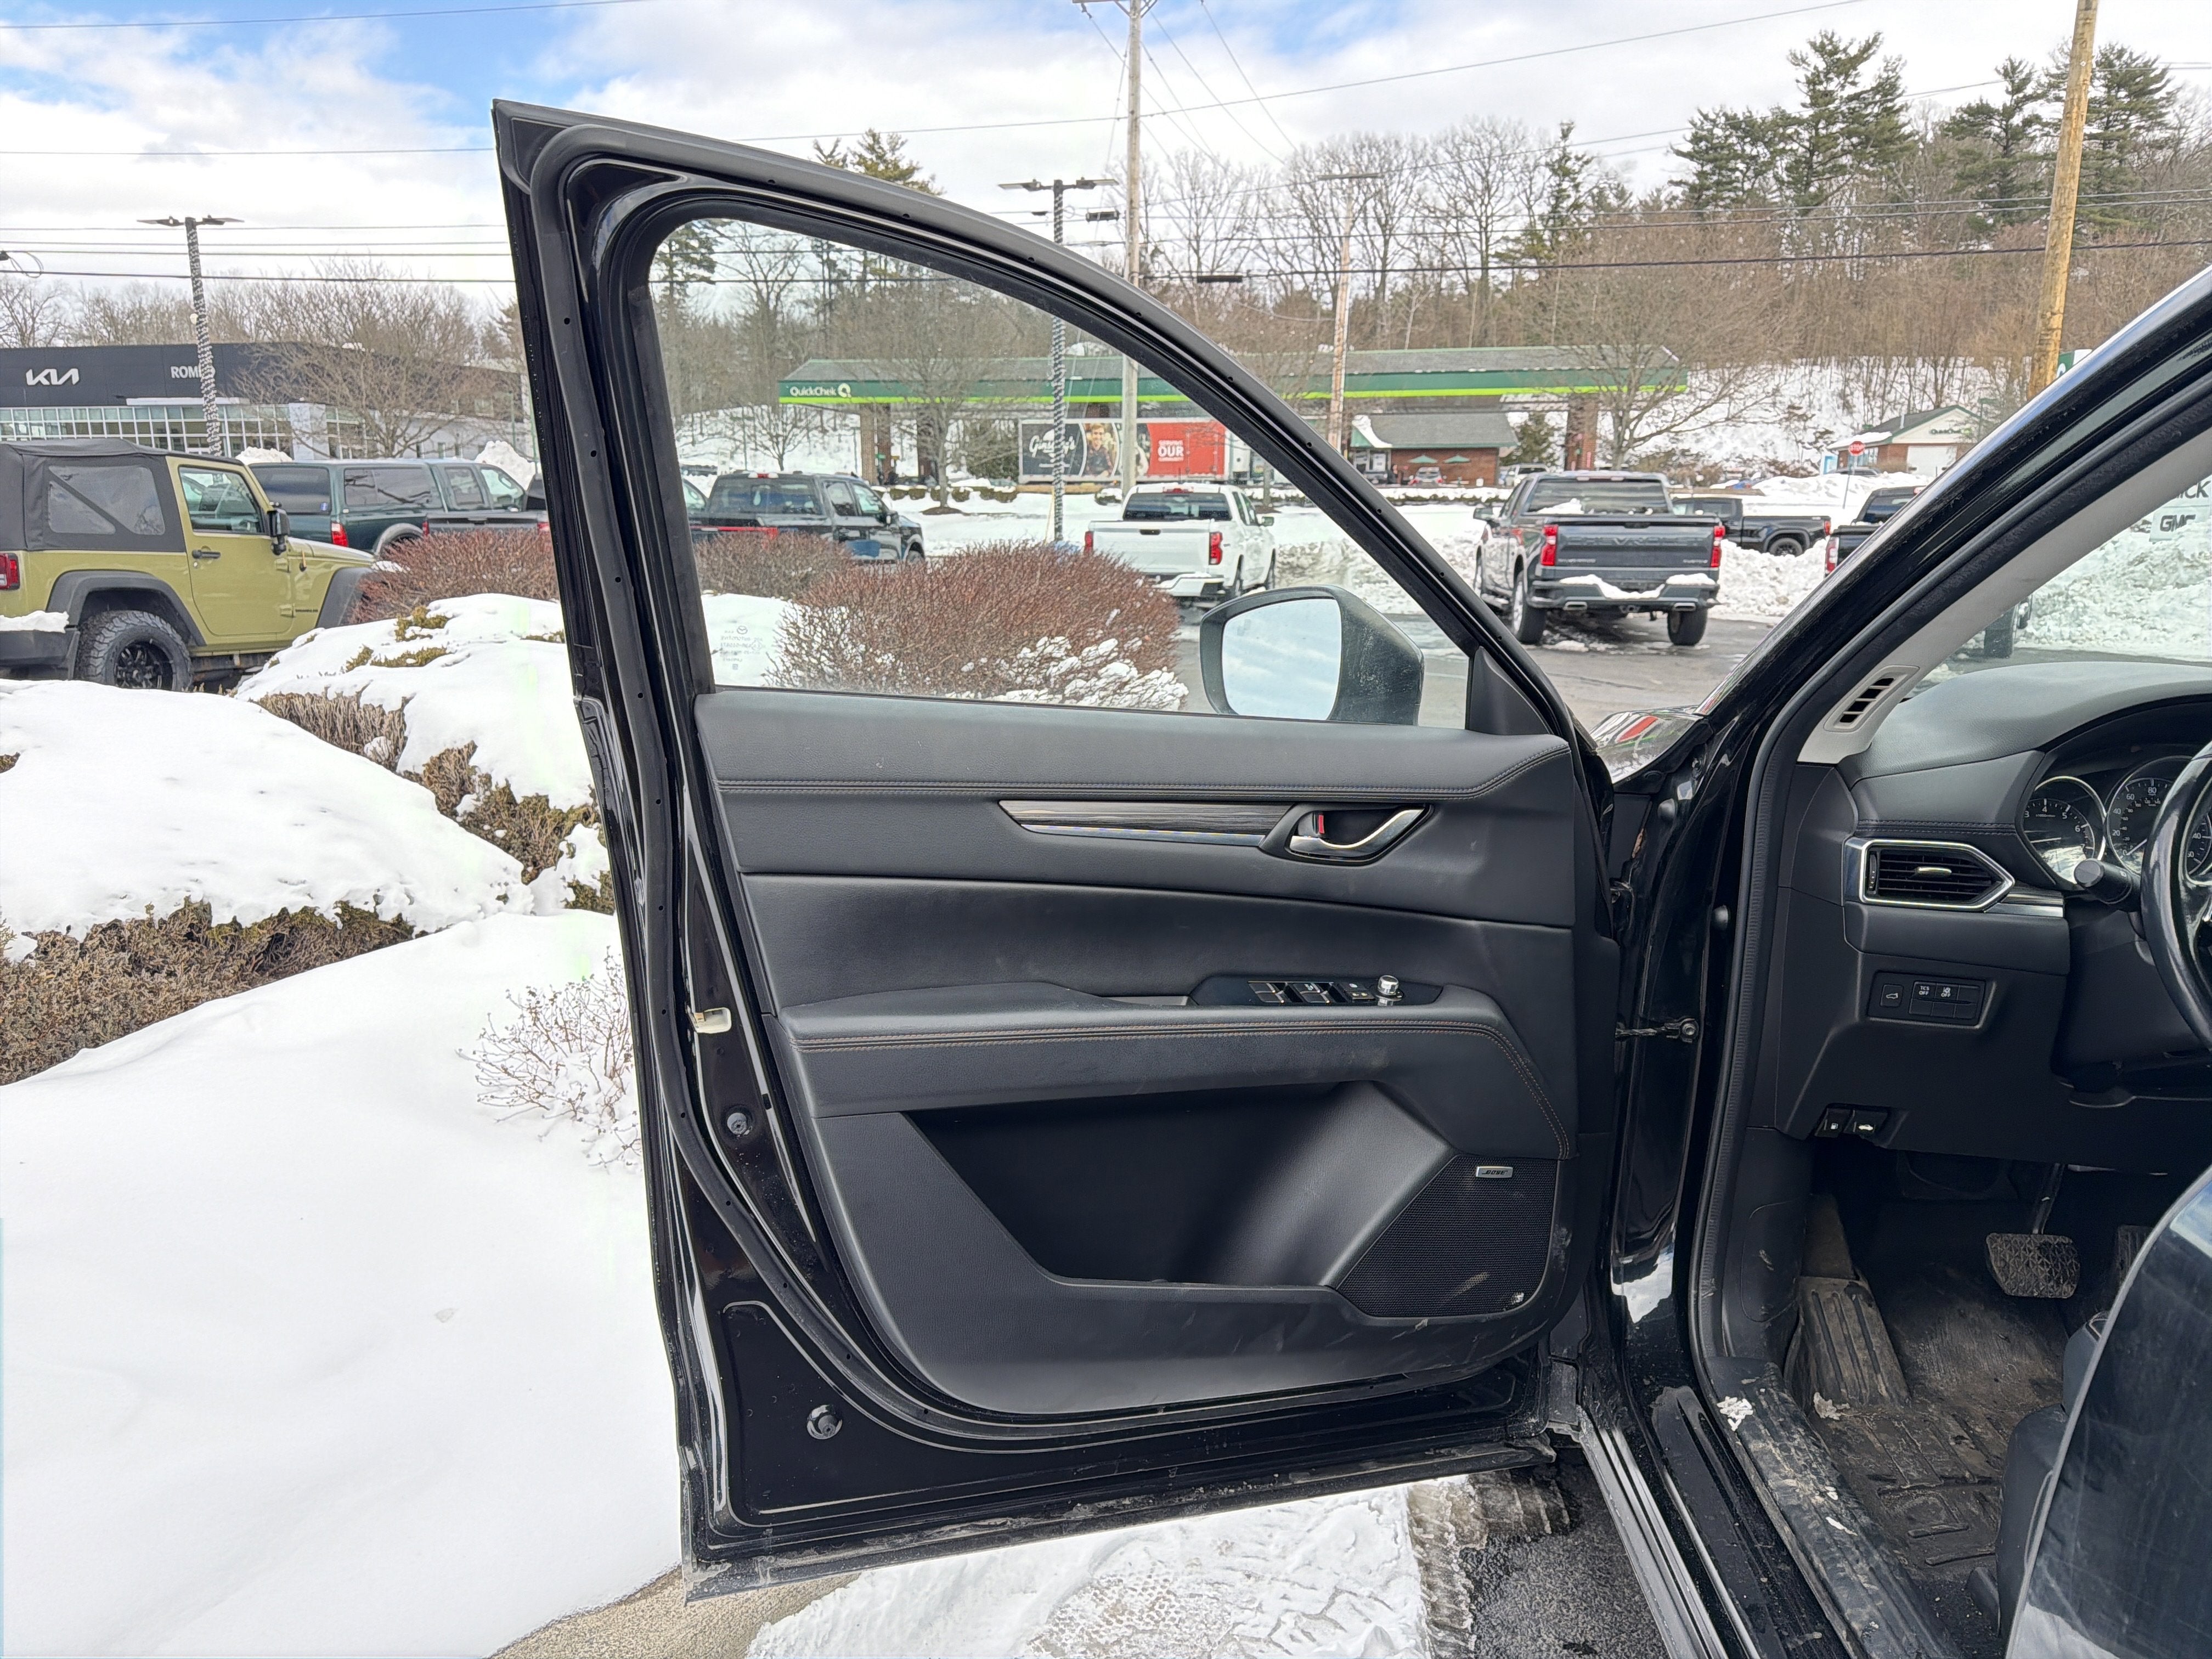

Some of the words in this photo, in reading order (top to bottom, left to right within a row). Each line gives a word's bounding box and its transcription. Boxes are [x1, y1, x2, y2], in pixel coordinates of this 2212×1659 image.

[26, 368, 80, 386] KIA
[170, 365, 216, 379] ROM
[1158, 445, 1184, 457] OUR
